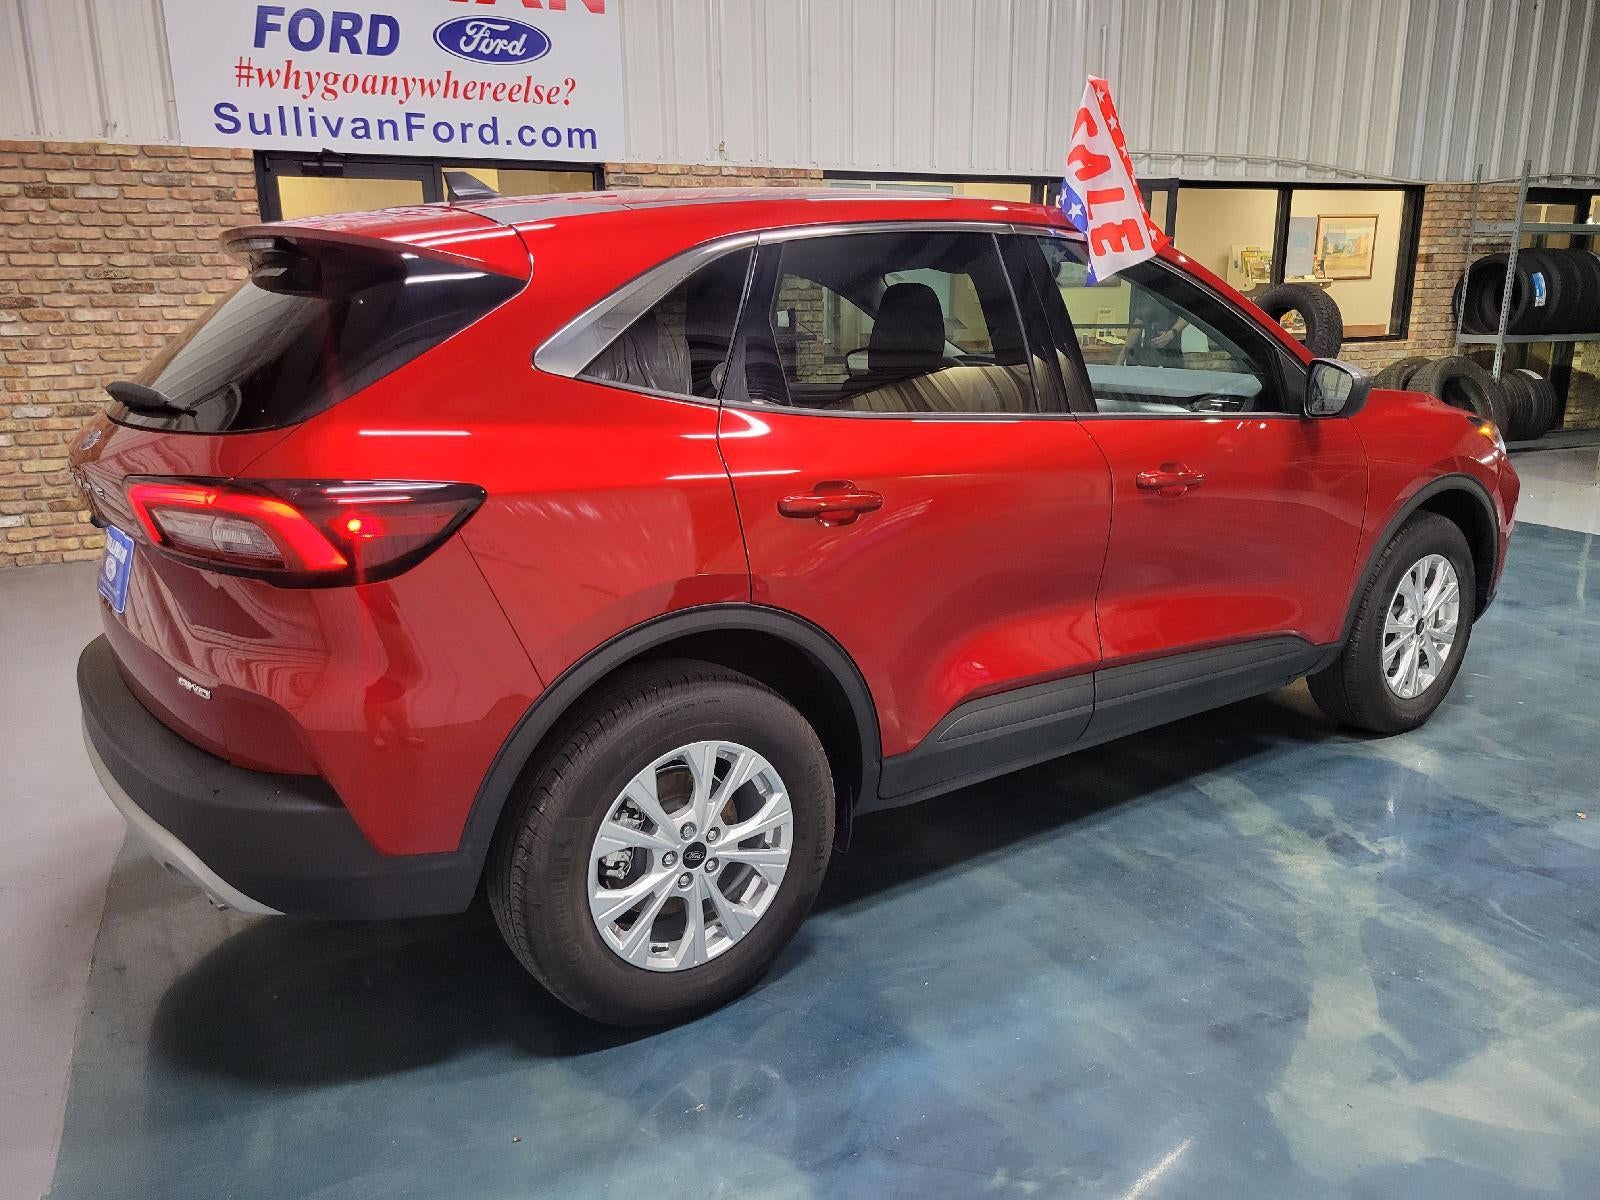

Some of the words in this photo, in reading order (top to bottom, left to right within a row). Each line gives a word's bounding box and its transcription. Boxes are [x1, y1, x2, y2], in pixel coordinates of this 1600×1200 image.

[254, 5, 400, 57] FORD
[459, 20, 528, 56] Ford
[234, 55, 577, 107] #whygoanywhereelse?
[213, 102, 598, 150] SullivanFord.com
